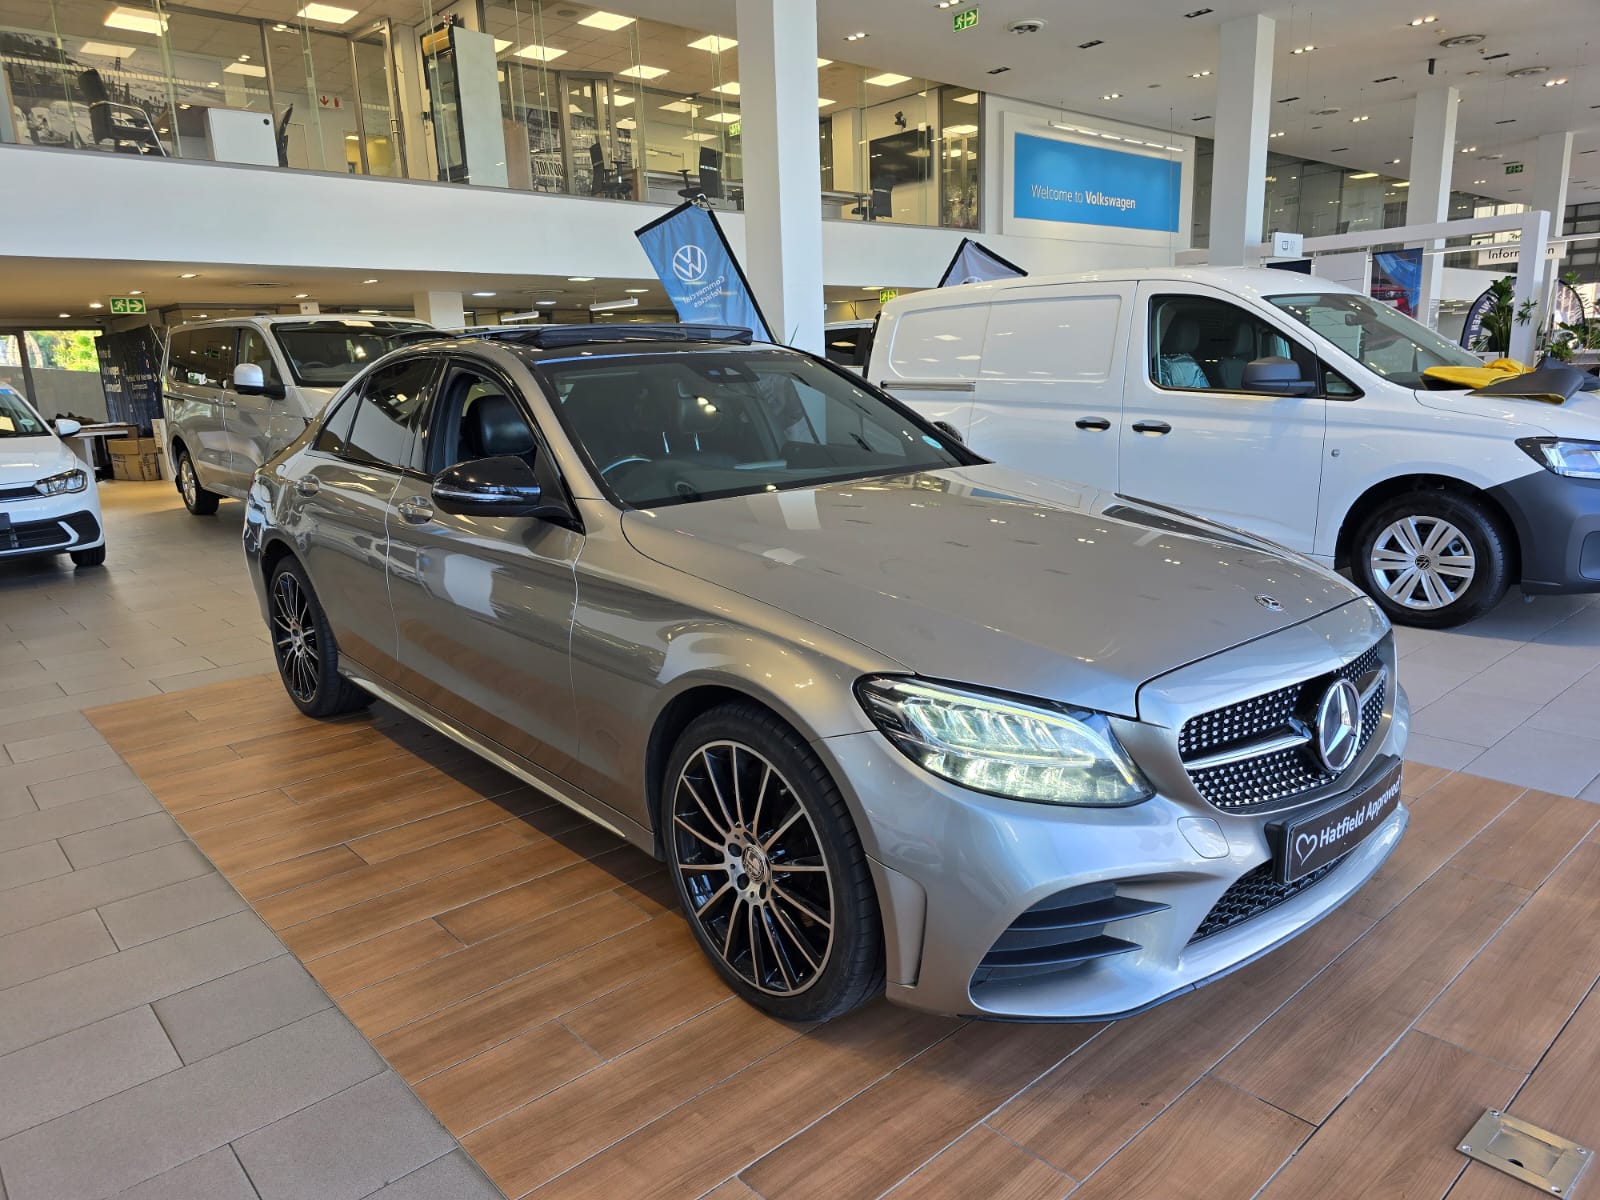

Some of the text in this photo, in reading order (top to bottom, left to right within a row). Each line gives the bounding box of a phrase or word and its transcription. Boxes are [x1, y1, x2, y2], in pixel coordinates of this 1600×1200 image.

[1031, 184, 1136, 211] Welcome to Volkswagen
[1320, 774, 1401, 848] Hatfield Approved
